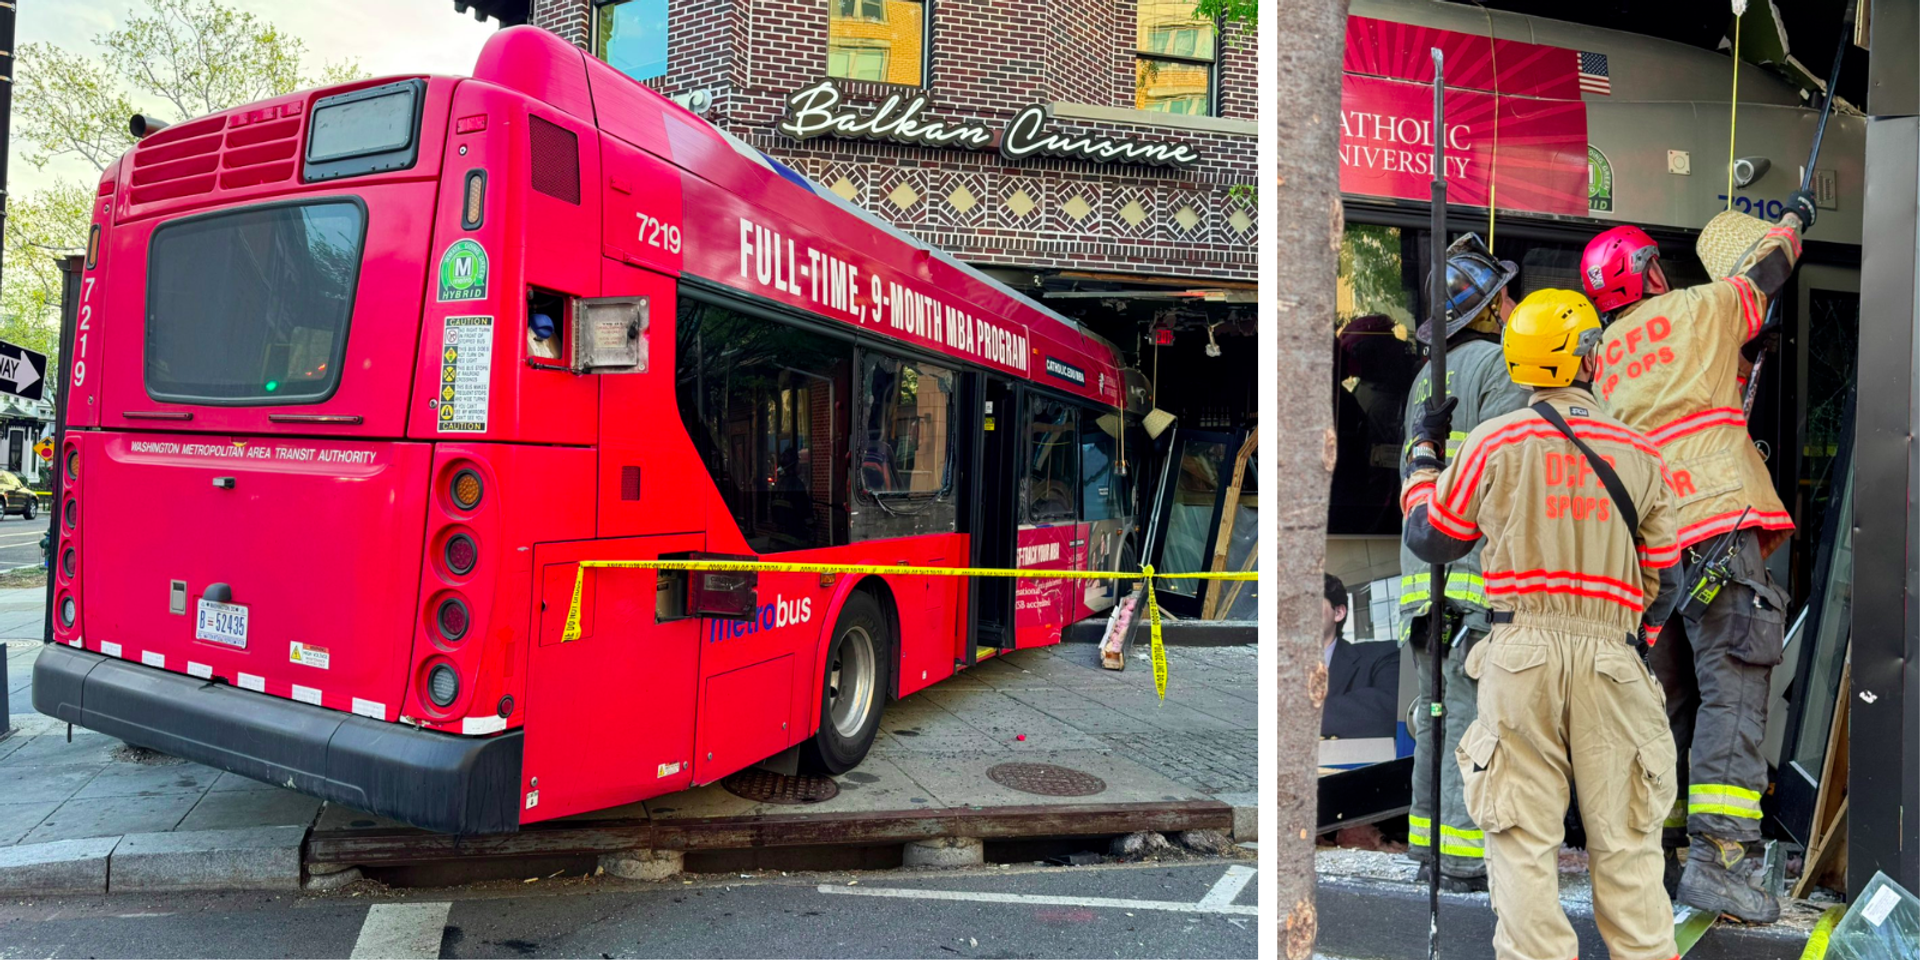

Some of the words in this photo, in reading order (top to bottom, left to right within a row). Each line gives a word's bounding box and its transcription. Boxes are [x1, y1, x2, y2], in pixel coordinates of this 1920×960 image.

[782, 81, 990, 144] Balkan
[1008, 108, 1198, 162] Cuisine
[1339, 110, 1471, 151] ATHOLIC
[1338, 144, 1471, 179] NIVERSITY
[636, 212, 681, 254] 7219
[454, 256, 472, 278] M
[442, 288, 482, 299] HYBRID
[740, 217, 866, 323] FULL-TIME,
[871, 274, 943, 343] 9-MONTH
[945, 305, 975, 354] MBA
[976, 318, 1027, 371] PROGRAM
[74, 277, 95, 387] 7219
[449, 318, 488, 326] CAUTION
[0, 357, 20, 379] AY
[1626, 346, 1675, 379] OPS
[442, 422, 482, 430] CAUTION
[131, 441, 179, 454] WASHINGTON
[181, 443, 245, 457] METROPOLITAN
[246, 446, 271, 459] AREA
[275, 447, 315, 461] TRANSIT
[317, 449, 377, 464] AUTHORITY
[199, 610, 206, 629] B
[215, 612, 245, 636] 52435
